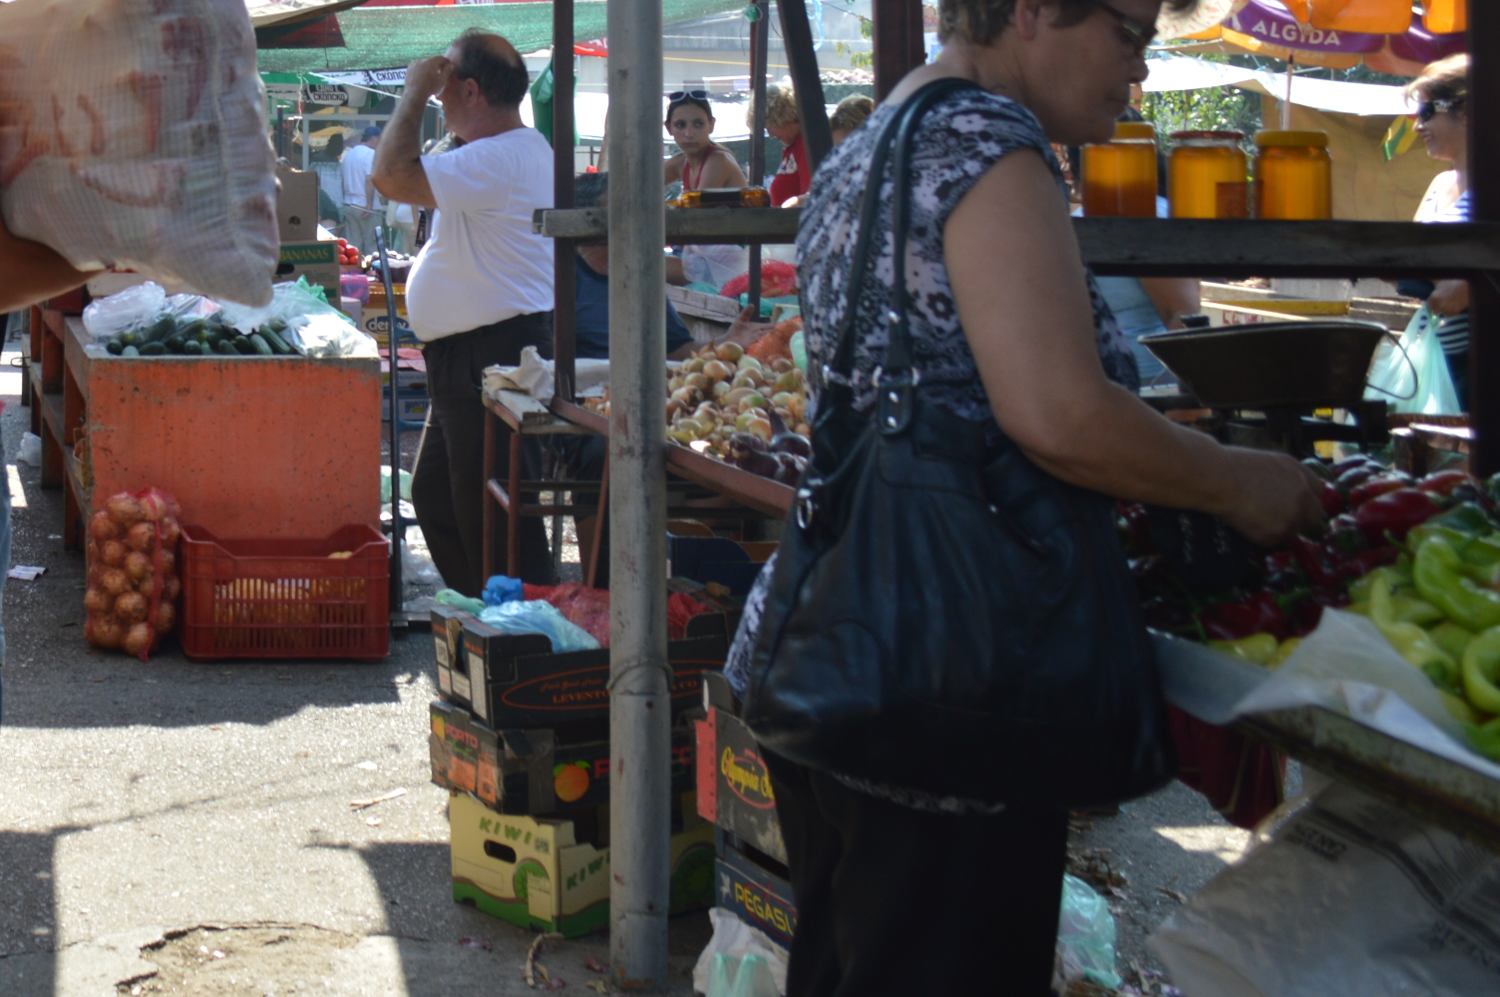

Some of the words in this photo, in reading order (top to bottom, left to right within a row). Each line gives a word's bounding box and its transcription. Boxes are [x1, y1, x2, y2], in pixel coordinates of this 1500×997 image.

[1251, 20, 1341, 46] ALGIDA
[479, 815, 533, 845] KIWI
[734, 881, 797, 937] PEGASU
